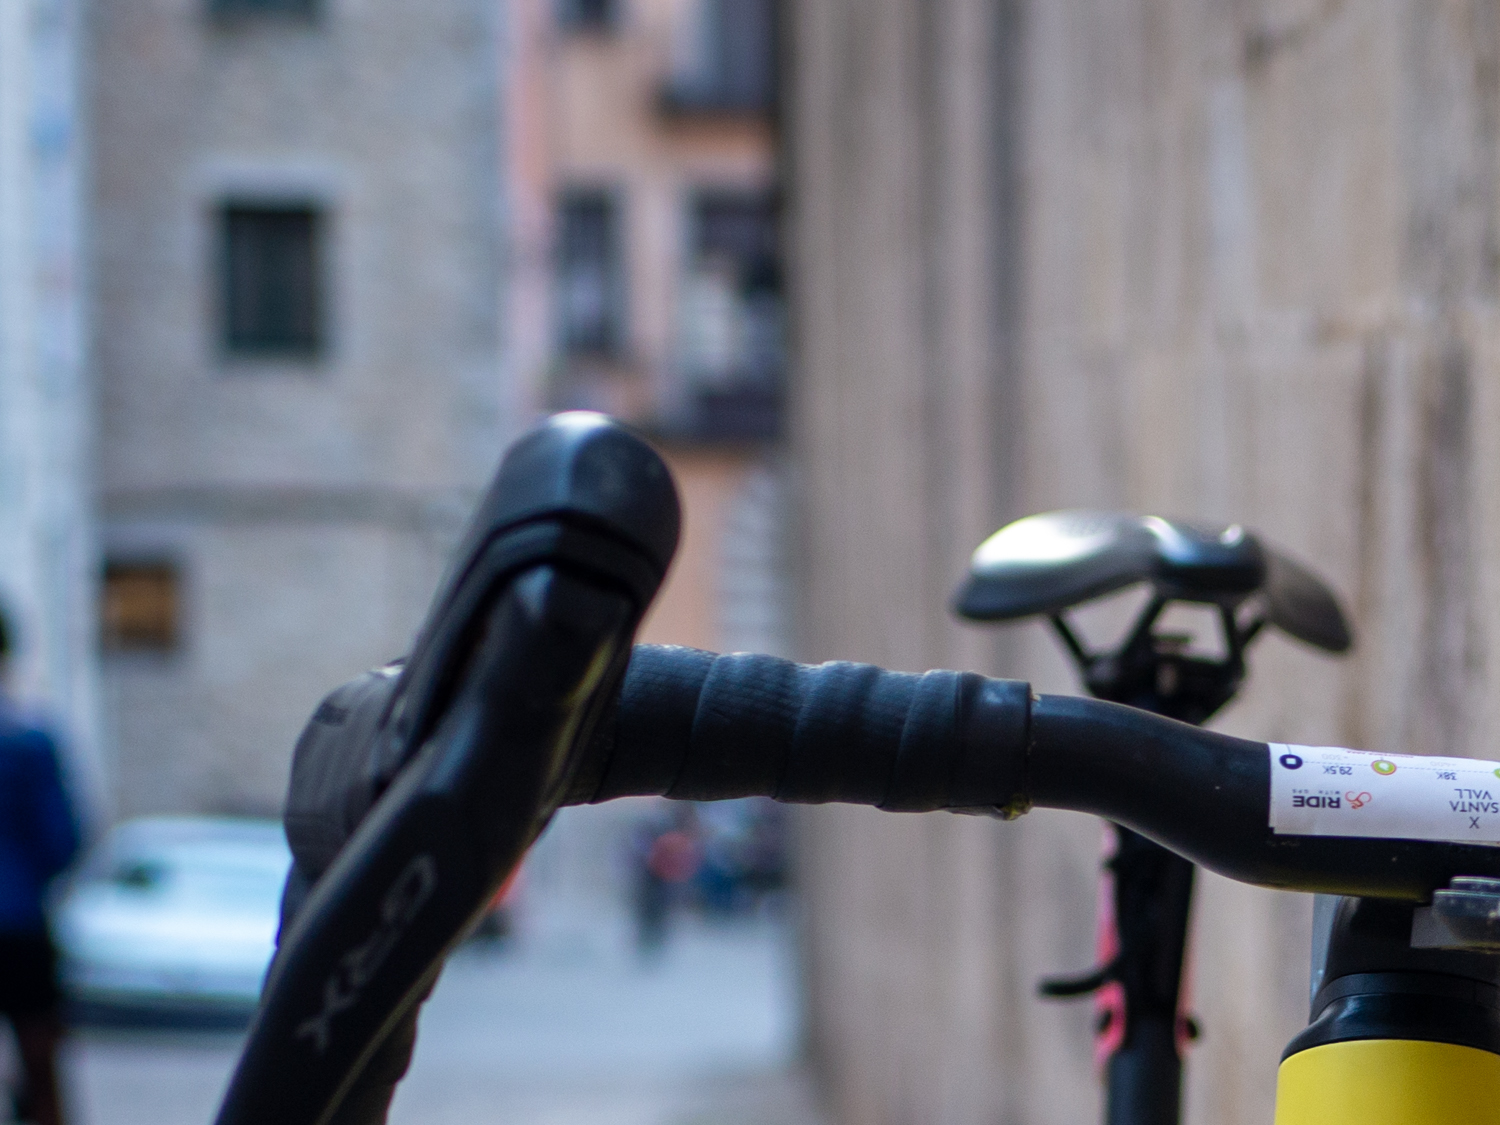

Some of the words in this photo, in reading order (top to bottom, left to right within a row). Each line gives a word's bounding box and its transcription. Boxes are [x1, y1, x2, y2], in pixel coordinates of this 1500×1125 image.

[1435, 771, 1458, 781] 38K
[1454, 788, 1493, 800] VALL
[1292, 795, 1341, 809] RIDE
[1449, 801, 1499, 814] SANTA
[1468, 816, 1480, 829] X
[296, 853, 438, 1054] GRX
